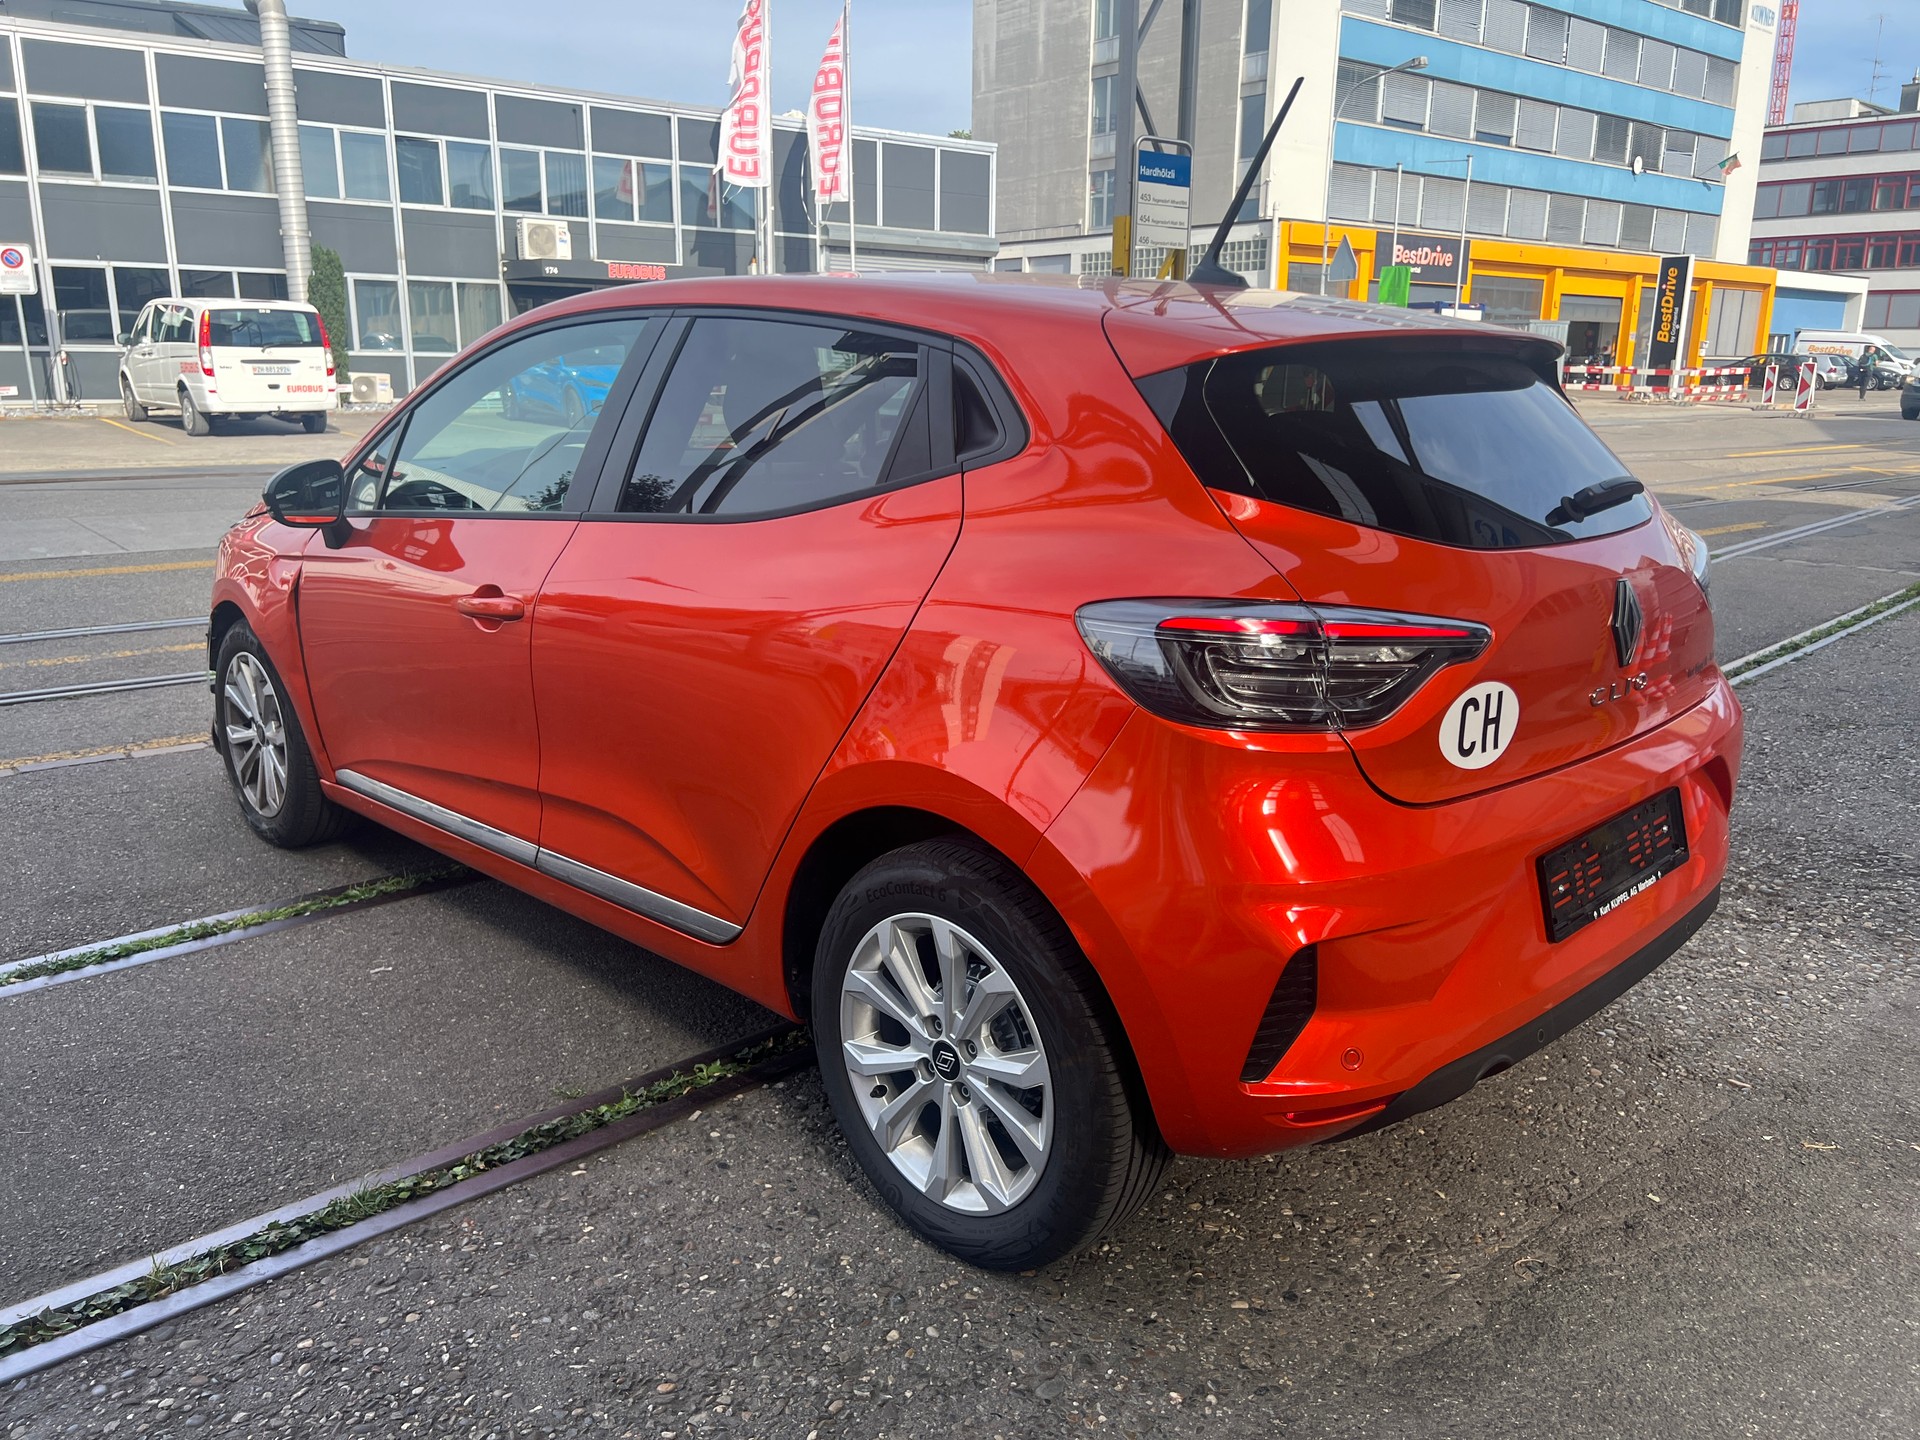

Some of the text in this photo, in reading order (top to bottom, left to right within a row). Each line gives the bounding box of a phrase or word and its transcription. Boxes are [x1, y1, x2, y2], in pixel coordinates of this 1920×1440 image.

[1140, 165, 1175, 179] Hardhölzli
[1140, 193, 1151, 202] 453
[1139, 214, 1150, 223] 454
[1138, 236, 1149, 244] 456
[1395, 244, 1453, 267] BestDrive
[545, 266, 558, 275] 174
[608, 263, 665, 280] EUROBUS
[1656, 267, 1679, 343] BestDrive
[1807, 345, 1853, 355] BestDrive
[287, 385, 323, 393] EUROBUS
[1588, 672, 1648, 707] CLIO
[1457, 690, 1504, 758] CH
[865, 881, 947, 904] EcoContact 6
[1599, 902, 1611, 917] Kurt
[1630, 886, 1638, 897] AG
